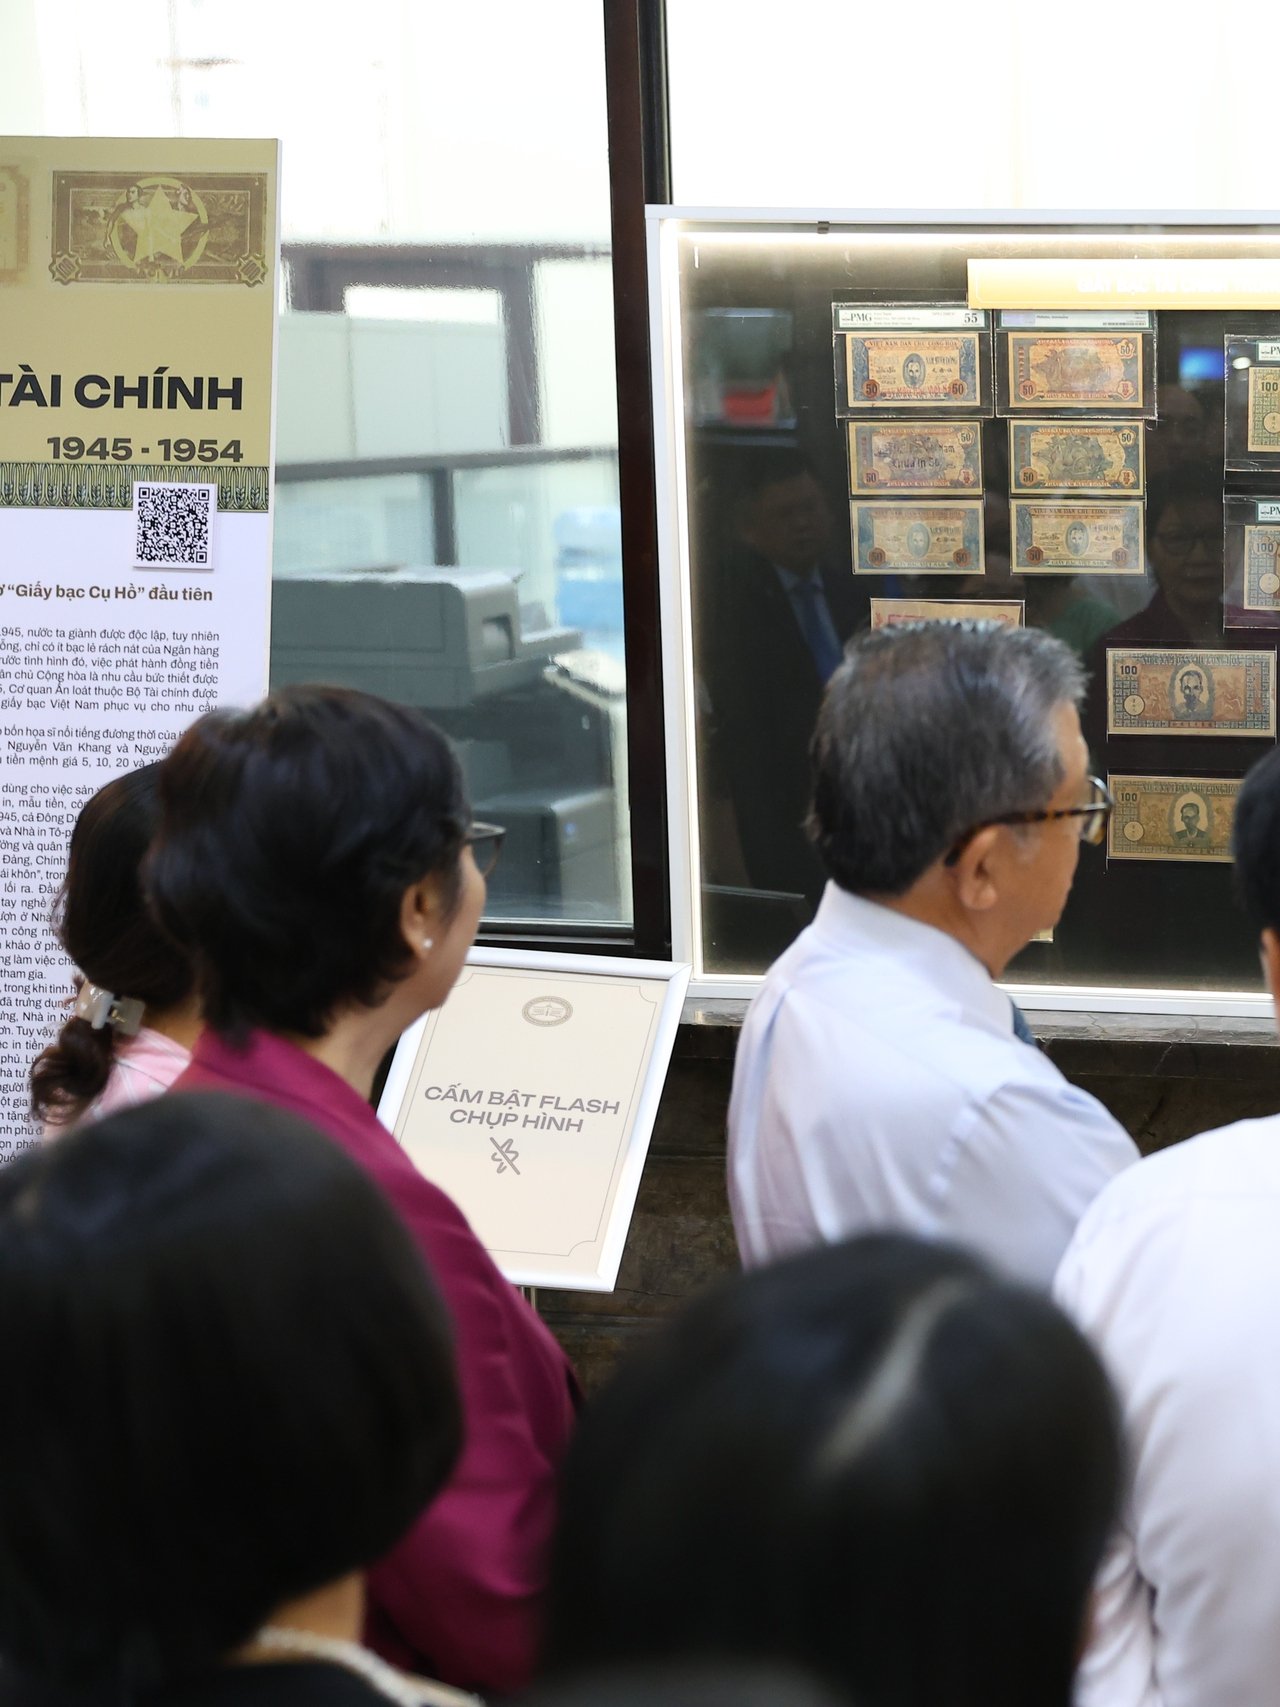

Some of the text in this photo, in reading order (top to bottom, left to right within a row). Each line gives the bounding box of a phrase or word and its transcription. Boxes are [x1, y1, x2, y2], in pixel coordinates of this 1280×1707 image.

[850, 312, 872, 322] PMG
[964, 313, 978, 323] 55
[74, 366, 243, 410] CHÍNH
[1261, 381, 1279, 392] 100
[1121, 433, 1132, 442] 50
[47, 437, 244, 462] 1945 1954
[1023, 472, 1034, 482] 50
[1256, 543, 1274, 553] 100
[56, 585, 85, 601] bạc
[89, 586, 110, 602] Cụ
[149, 584, 178, 600] đầu
[182, 587, 213, 601] tiên
[27, 627, 219, 643] nước ta giành được độc lập, tuy nhiên
[42, 642, 55, 652] có
[66, 643, 85, 654] bạc
[99, 643, 120, 654] rách
[123, 644, 139, 654] nát
[142, 644, 160, 654] của
[163, 645, 191, 656] Ngân
[193, 646, 219, 657] hàng
[24, 656, 43, 666] tình
[47, 656, 68, 666] hình
[91, 657, 112, 669] việc
[115, 658, 138, 669] phát
[142, 659, 167, 669] hành
[170, 657, 197, 671] đồng
[200, 658, 219, 670] tiền
[1120, 665, 1138, 675] 100
[14, 670, 218, 686] chủ Cộng hòa là nhu cầu bức thiết được
[9, 684, 25, 694] Cơ
[27, 686, 52, 696] quan
[73, 685, 92, 696] loát
[94, 686, 123, 698] thuộc
[126, 687, 141, 698] Bộ
[144, 687, 159, 697] Tài
[161, 688, 190, 698] chính
[193, 688, 218, 700] được
[1, 696, 194, 713] giấy bạc Việt Nam phục vụ cho nhu
[4, 724, 24, 736] bốn
[25, 726, 45, 738] họa
[47, 727, 56, 737] sĩ
[75, 726, 101, 740] tiếng
[102, 729, 135, 741] đương
[137, 730, 156, 740] thời
[158, 730, 177, 740] của
[7, 739, 129, 755] Nguyễn Văn Khang và
[6, 753, 25, 765] tiền
[29, 756, 59, 768] mệnh
[62, 757, 78, 769] giá
[82, 757, 92, 768] 5,
[96, 758, 112, 768] 10,
[116, 758, 129, 768] 20
[1, 783, 94, 796] dùng cho việc sản
[2, 797, 14, 808] in,
[18, 796, 41, 808] mẫu
[45, 796, 67, 810] tiền,
[1121, 793, 1138, 803] 100
[36, 812, 64, 825] Đông
[0, 826, 46, 837] và Nhà in
[22, 841, 34, 851] và
[37, 841, 62, 852] quân
[36, 855, 66, 865] Chính
[5, 881, 16, 893] lối
[21, 885, 33, 893] ra.
[2, 898, 16, 909] tay
[21, 896, 46, 909] nghề
[12, 926, 37, 938] công
[14, 954, 56, 967] làm việc
[1, 969, 46, 981] tham gia.
[4, 983, 68, 995] trong khi tình
[0, 996, 41, 1009] đã trưng
[23, 1011, 44, 1021] Nhà
[47, 1012, 56, 1021] in
[16, 1026, 34, 1037] Tuy
[12, 1038, 44, 1050] in tiền
[15, 1069, 26, 1078] tư
[13, 1097, 28, 1108] gia
[424, 1083, 621, 1115] CẤM BẬT FLASH
[7, 1110, 30, 1123] tặng
[449, 1109, 584, 1133] CHỤP HÌNH
